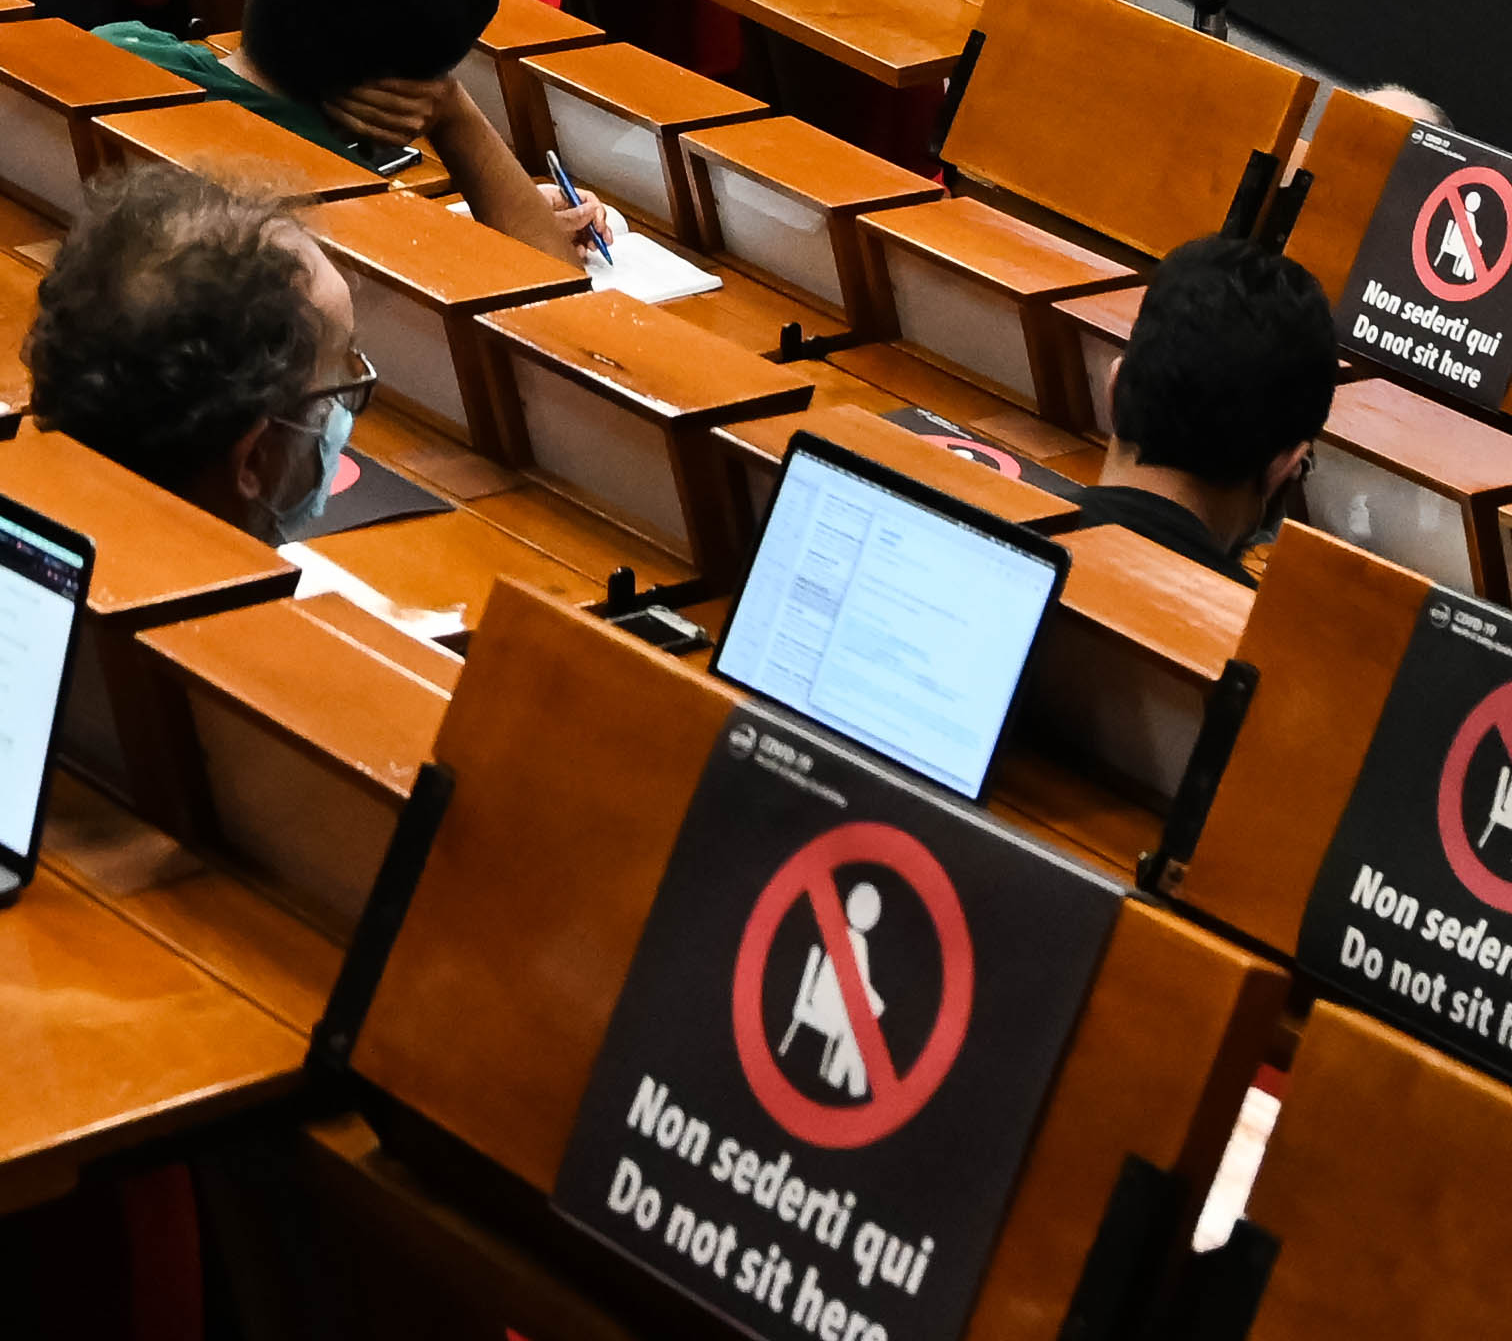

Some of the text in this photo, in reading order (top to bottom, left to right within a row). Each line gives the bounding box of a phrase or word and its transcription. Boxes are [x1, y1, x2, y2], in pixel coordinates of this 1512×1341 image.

[1352, 314, 1482, 389] Do not sit here
[1362, 280, 1503, 357] Non sederti qui
[1350, 864, 1417, 930] Non
[1342, 926, 1383, 980] Do
[1390, 959, 1447, 1013] not
[1449, 988, 1494, 1037] sit
[626, 1075, 935, 1295] Non sederti qui
[607, 1158, 889, 1341] Do not sit here
